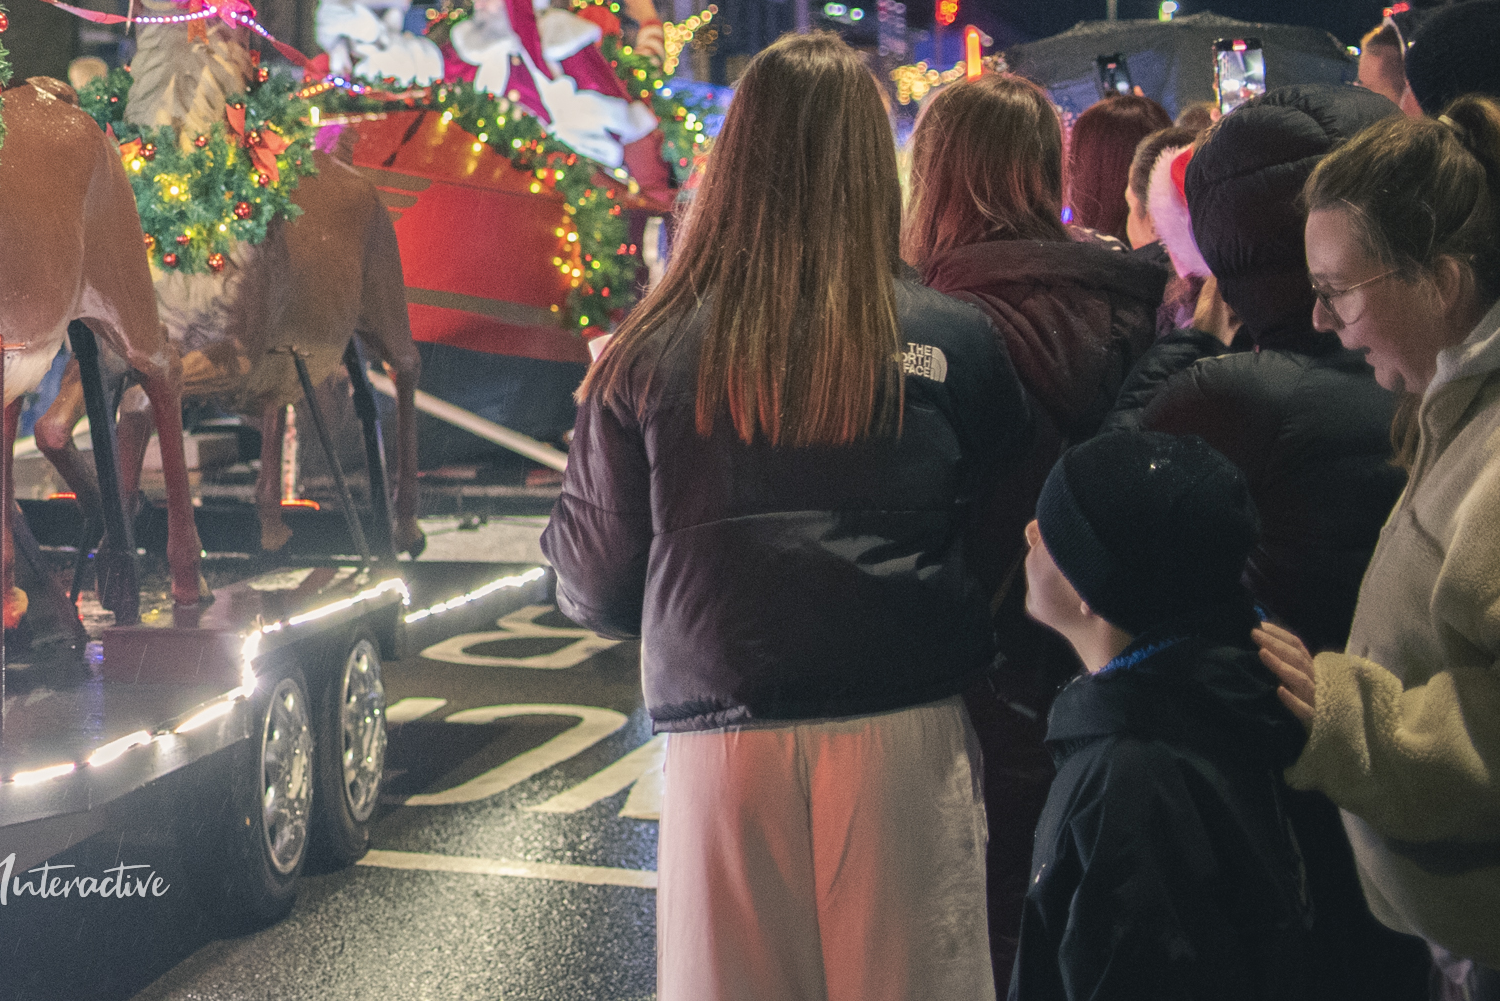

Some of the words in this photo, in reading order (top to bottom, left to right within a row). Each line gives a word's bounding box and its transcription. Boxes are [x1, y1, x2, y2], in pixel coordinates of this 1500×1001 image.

[907, 342, 932, 356] THE
[901, 351, 932, 368] ORTH
[903, 362, 931, 378] FACE
